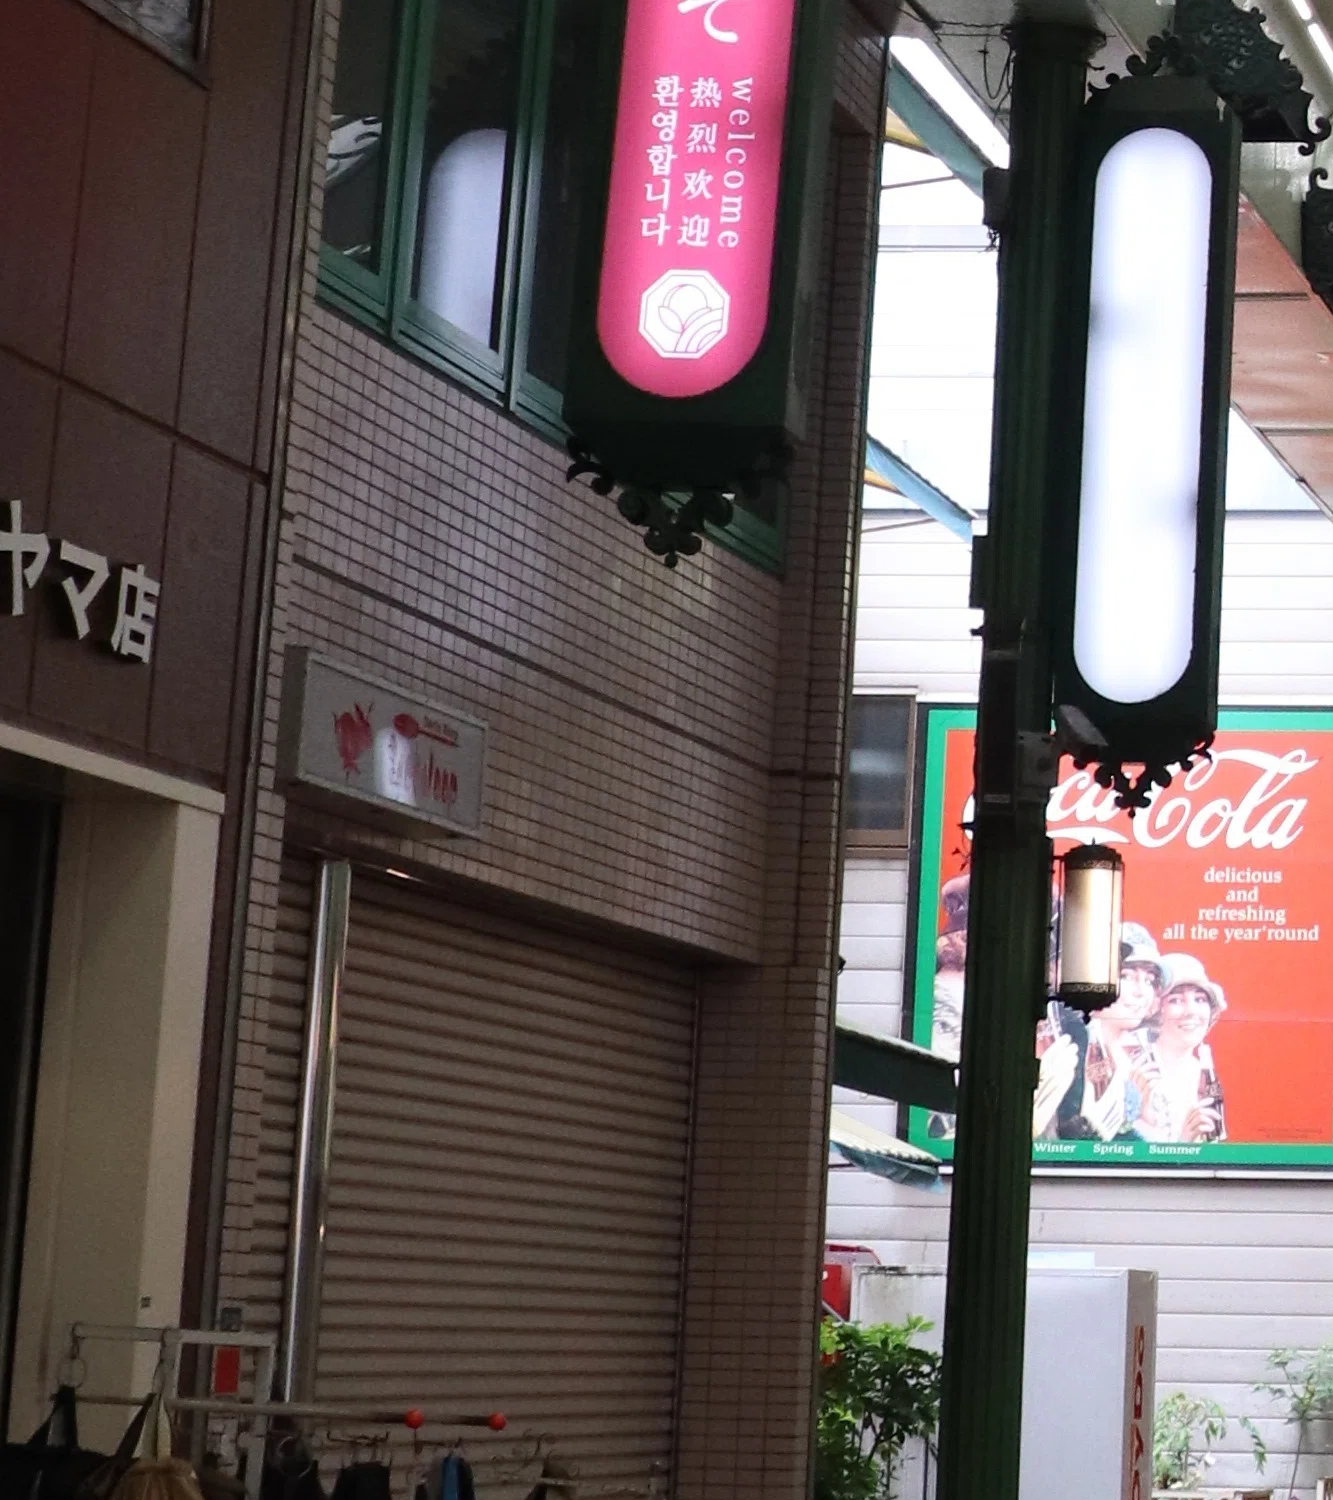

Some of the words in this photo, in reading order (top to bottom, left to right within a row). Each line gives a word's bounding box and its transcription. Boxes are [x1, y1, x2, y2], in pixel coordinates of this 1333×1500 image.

[641, 75, 684, 246] 환영합니다
[677, 77, 722, 248] 热烈欢迎
[718, 77, 755, 248] welcome
[1204, 867, 1282, 883] delicious
[1225, 887, 1259, 902] and
[1198, 905, 1286, 926] refreshing
[1162, 925, 1185, 940] all
[1190, 925, 1218, 940] the
[1034, 1142, 1076, 1154] Winter
[1094, 1142, 1134, 1156] Spring
[1149, 1144, 1200, 1156] Summer
